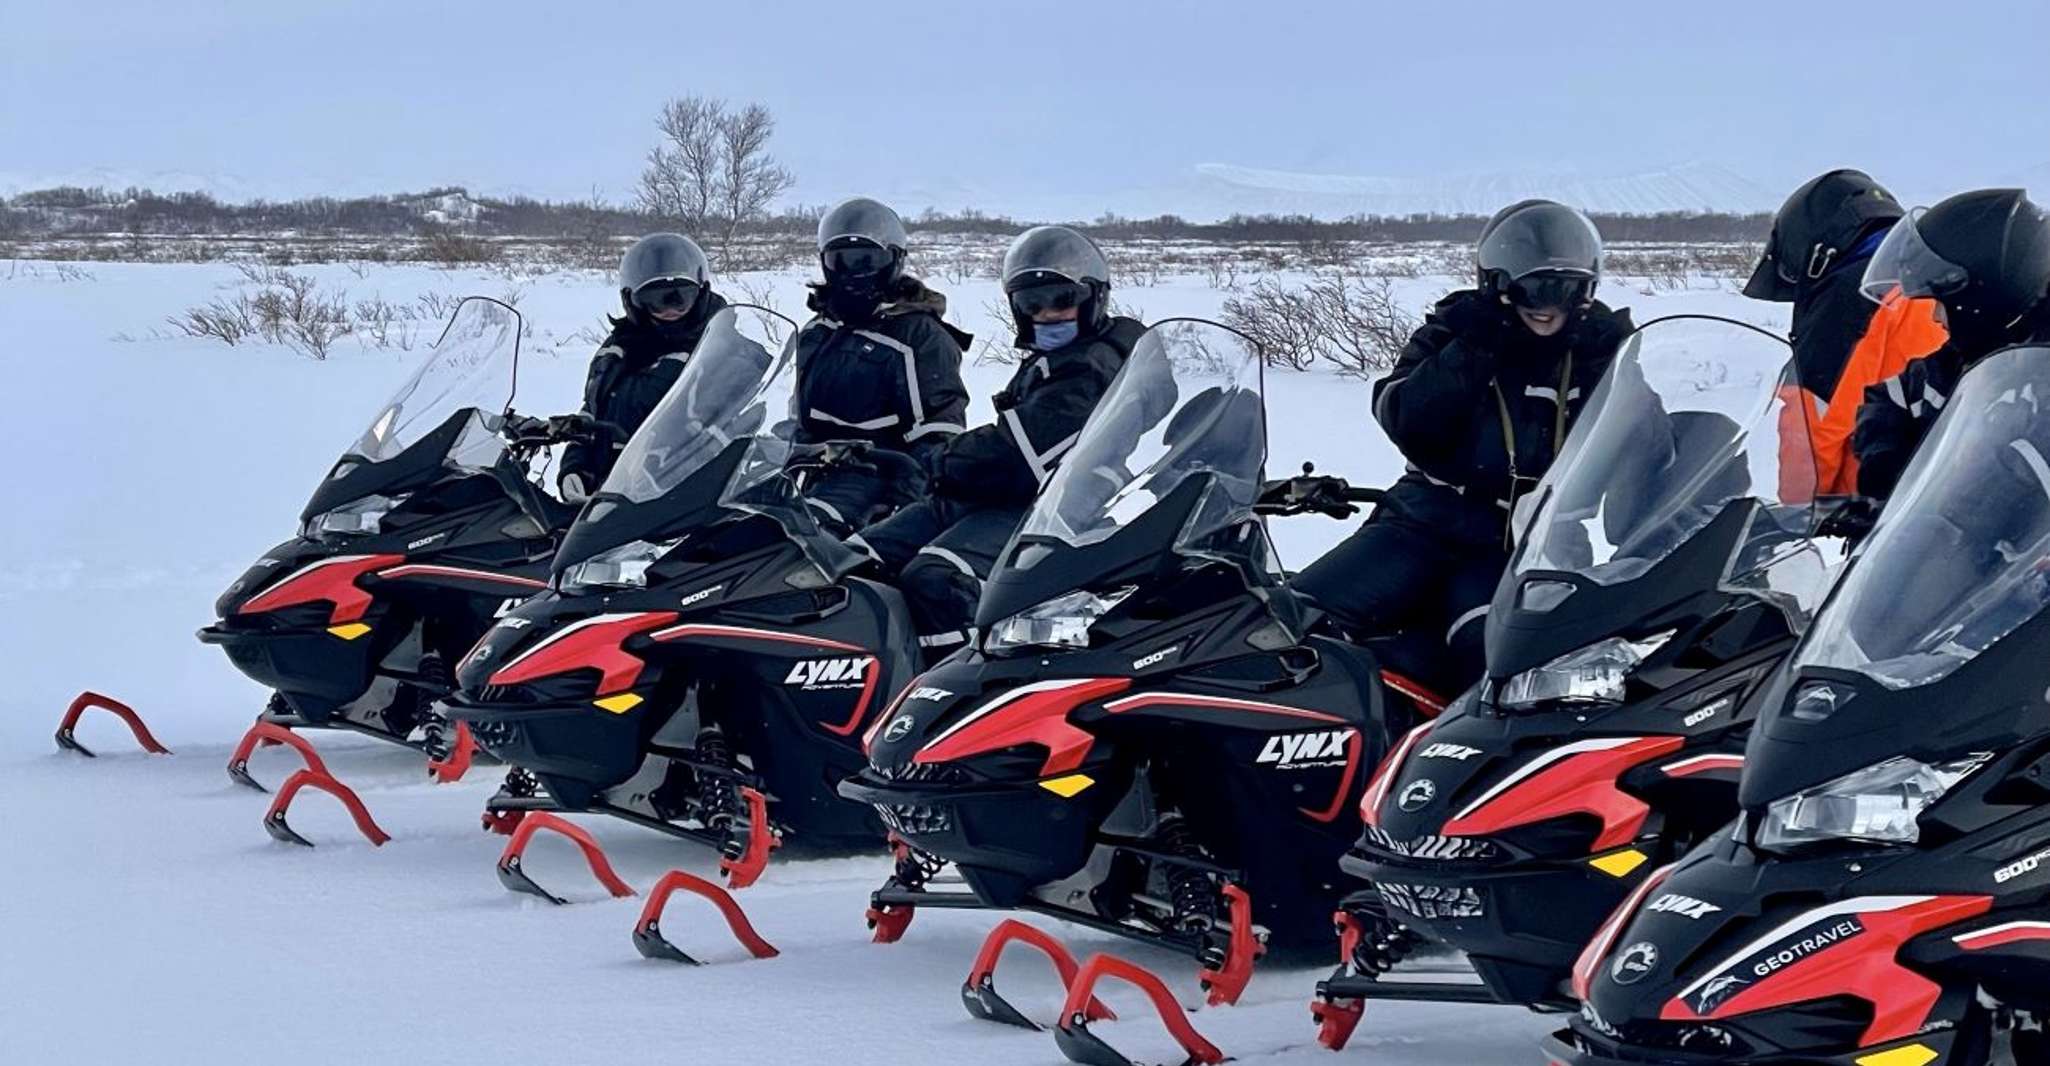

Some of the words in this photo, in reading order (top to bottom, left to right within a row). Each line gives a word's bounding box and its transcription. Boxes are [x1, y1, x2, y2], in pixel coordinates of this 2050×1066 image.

[681, 590, 709, 606] 600
[783, 657, 874, 686] LYNX
[1133, 651, 1163, 670] 600
[1684, 705, 1715, 727] 600
[1256, 729, 1357, 764] LYNX
[1418, 743, 1484, 760] LYNX
[1993, 856, 2039, 884] 600
[1647, 894, 1723, 919] LYNX
[1753, 920, 1862, 976] GEOTRAVEL
